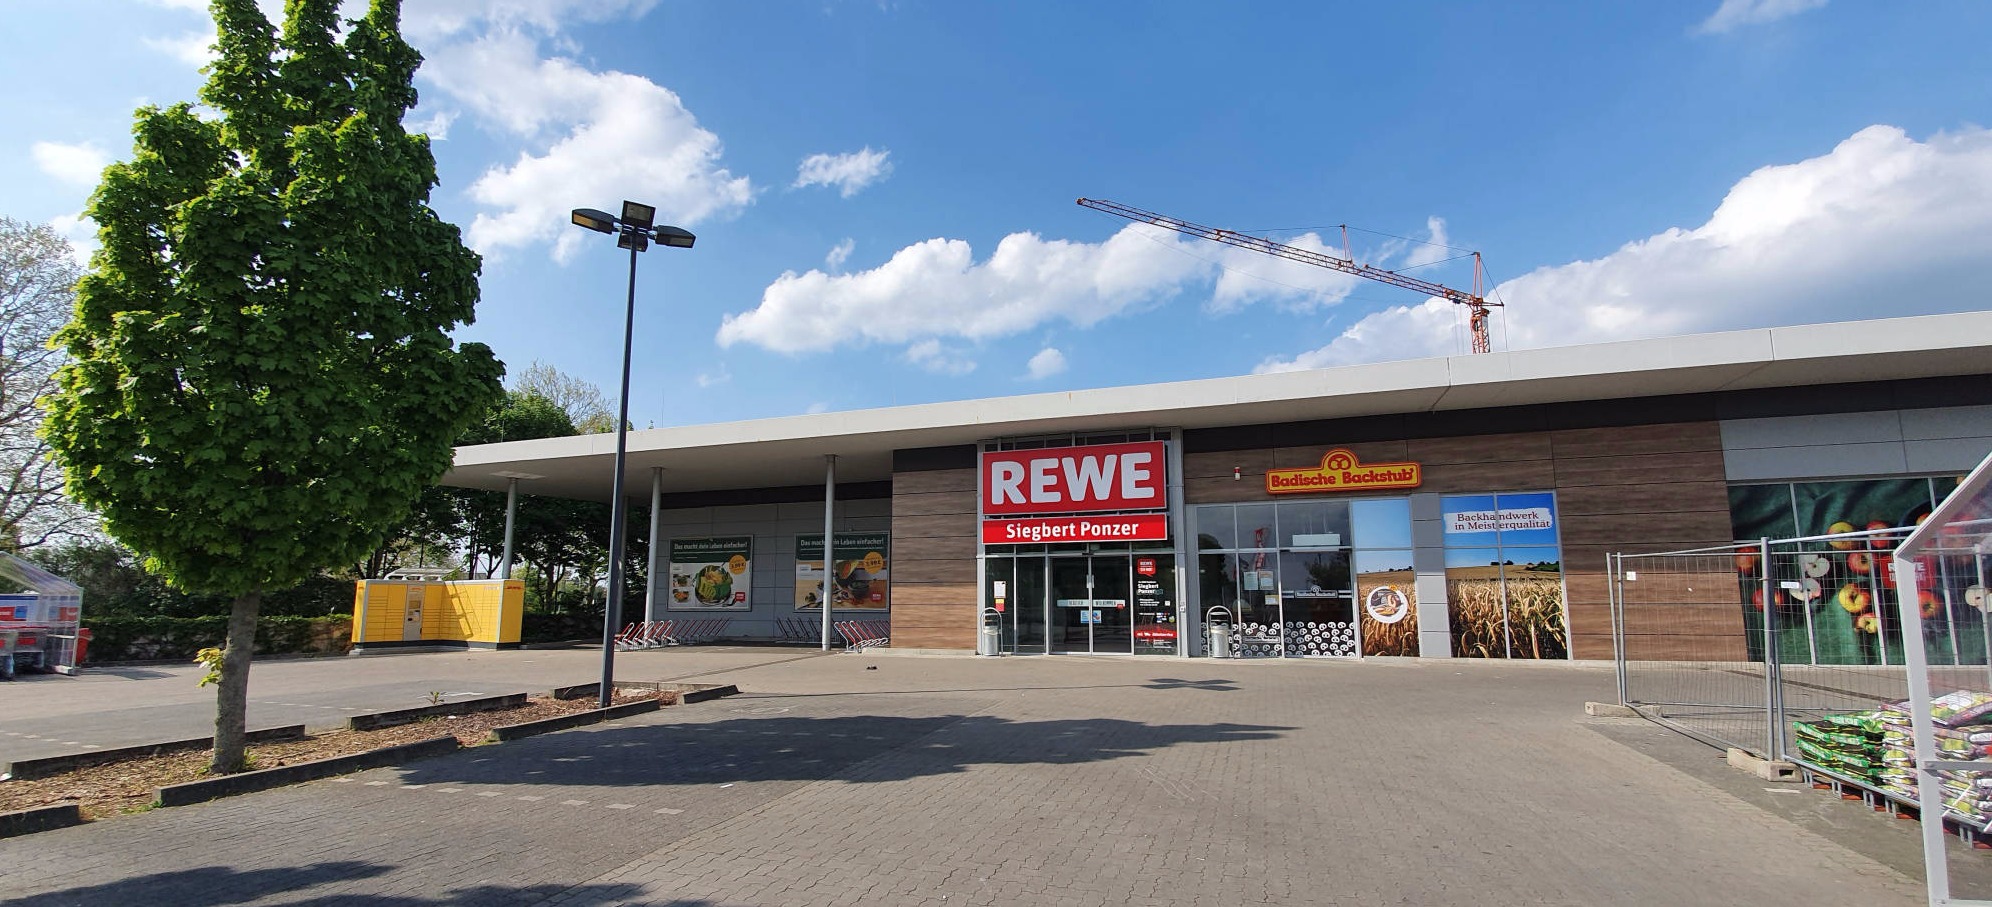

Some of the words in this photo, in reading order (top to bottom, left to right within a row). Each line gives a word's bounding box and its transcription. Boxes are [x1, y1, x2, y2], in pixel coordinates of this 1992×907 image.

[992, 452, 1155, 505] REWE
[1271, 474, 1336, 487] Badische
[1457, 511, 1539, 522] Backhandwerk
[1006, 522, 1076, 541] Siegbert
[1080, 521, 1139, 536] Ponzer
[1455, 523, 1465, 531] in
